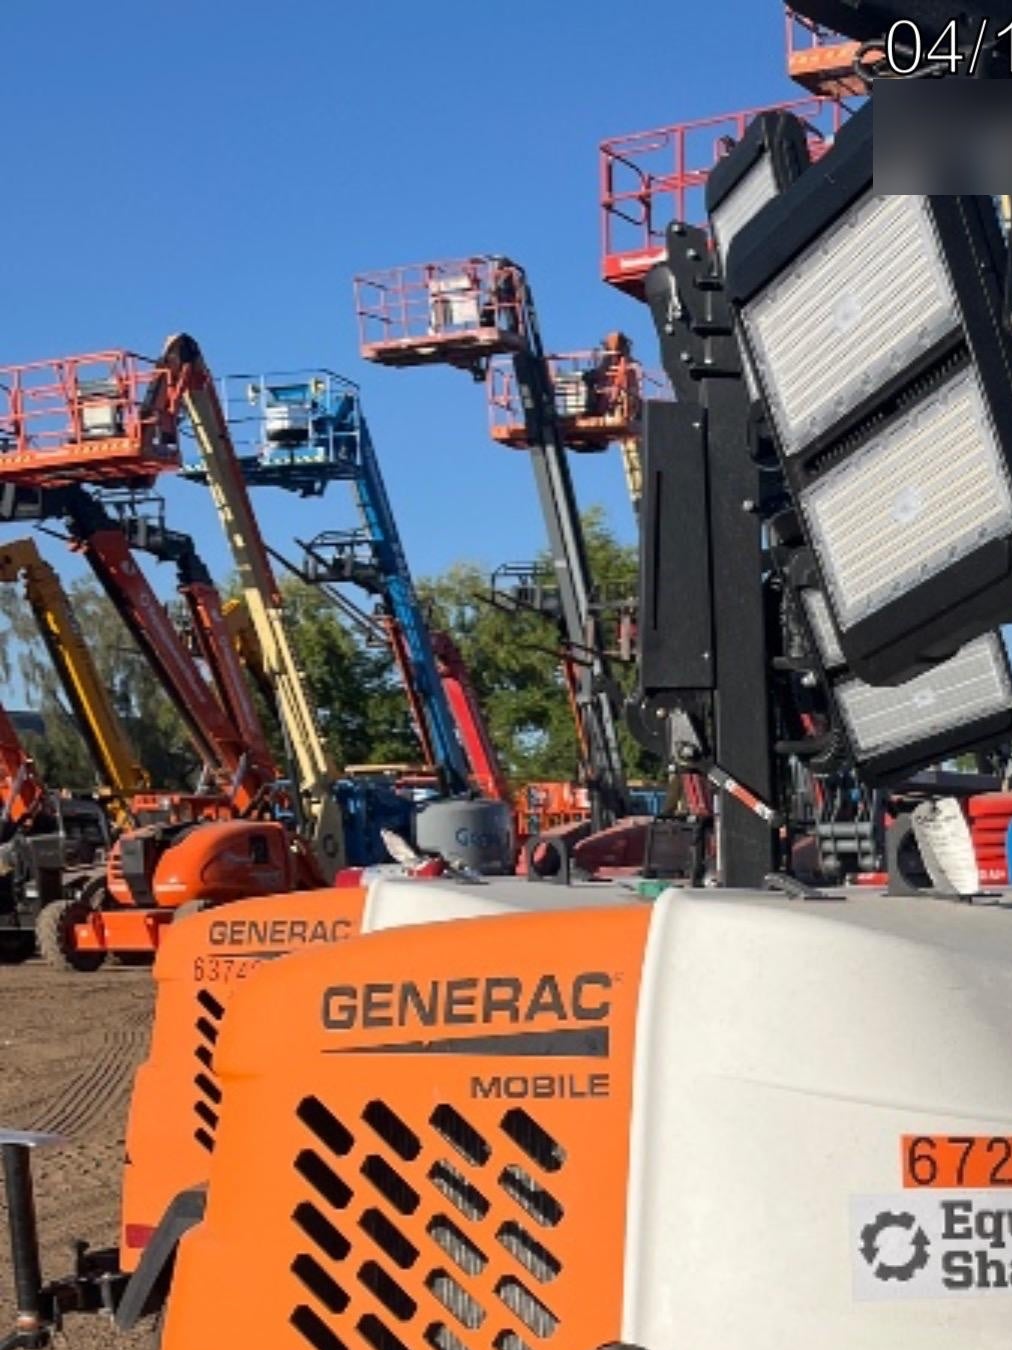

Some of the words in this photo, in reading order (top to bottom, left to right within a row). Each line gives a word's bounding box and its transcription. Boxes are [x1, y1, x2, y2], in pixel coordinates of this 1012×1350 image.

[208, 919, 352, 945] GENERAC
[321, 971, 612, 1030] GENERAC
[470, 1073, 611, 1099] MOBILE
